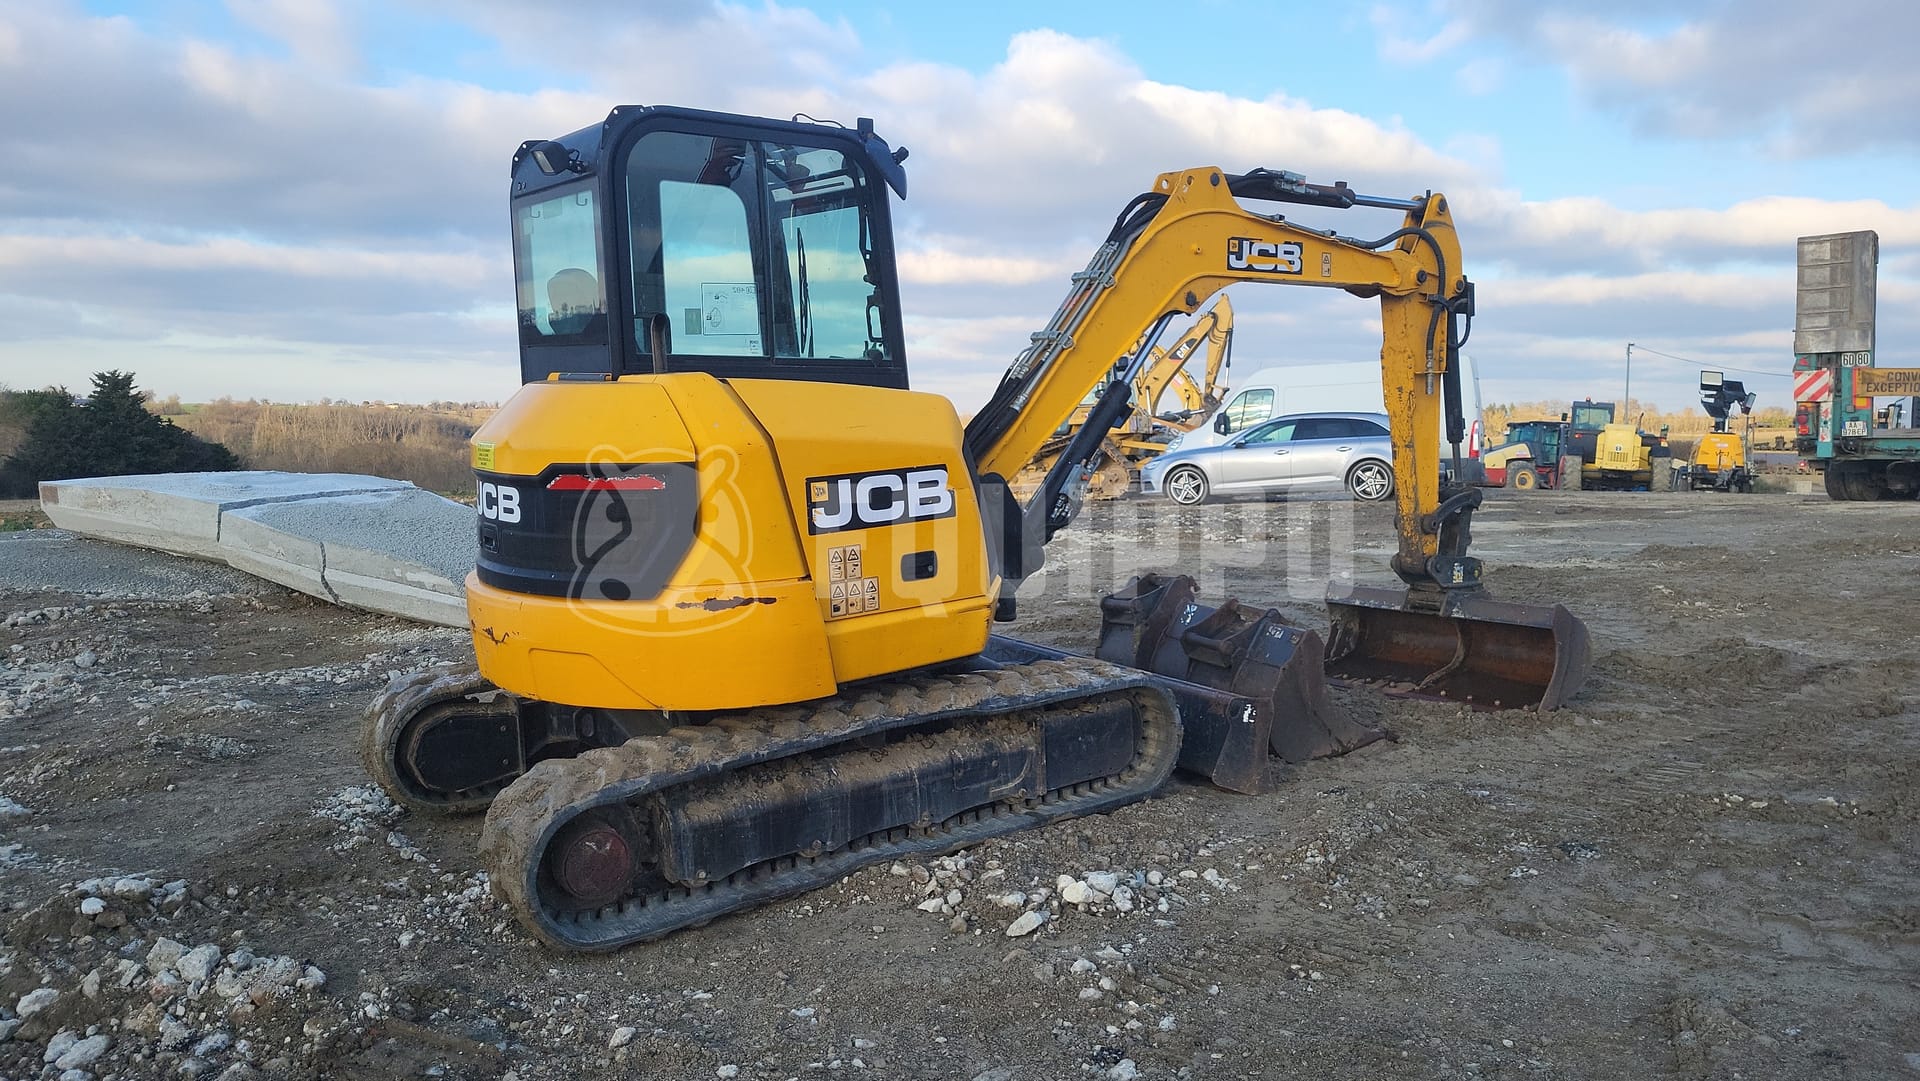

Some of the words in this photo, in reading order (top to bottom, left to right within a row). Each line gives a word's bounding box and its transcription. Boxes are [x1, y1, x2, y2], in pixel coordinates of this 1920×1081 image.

[1229, 240, 1301, 272] JCB
[1176, 342, 1190, 359] CAT
[1857, 352, 1869, 365] 80
[1842, 353, 1855, 366] 60
[1887, 371, 1920, 382] CONV
[477, 480, 521, 524] JCB
[812, 469, 952, 529] JCB
